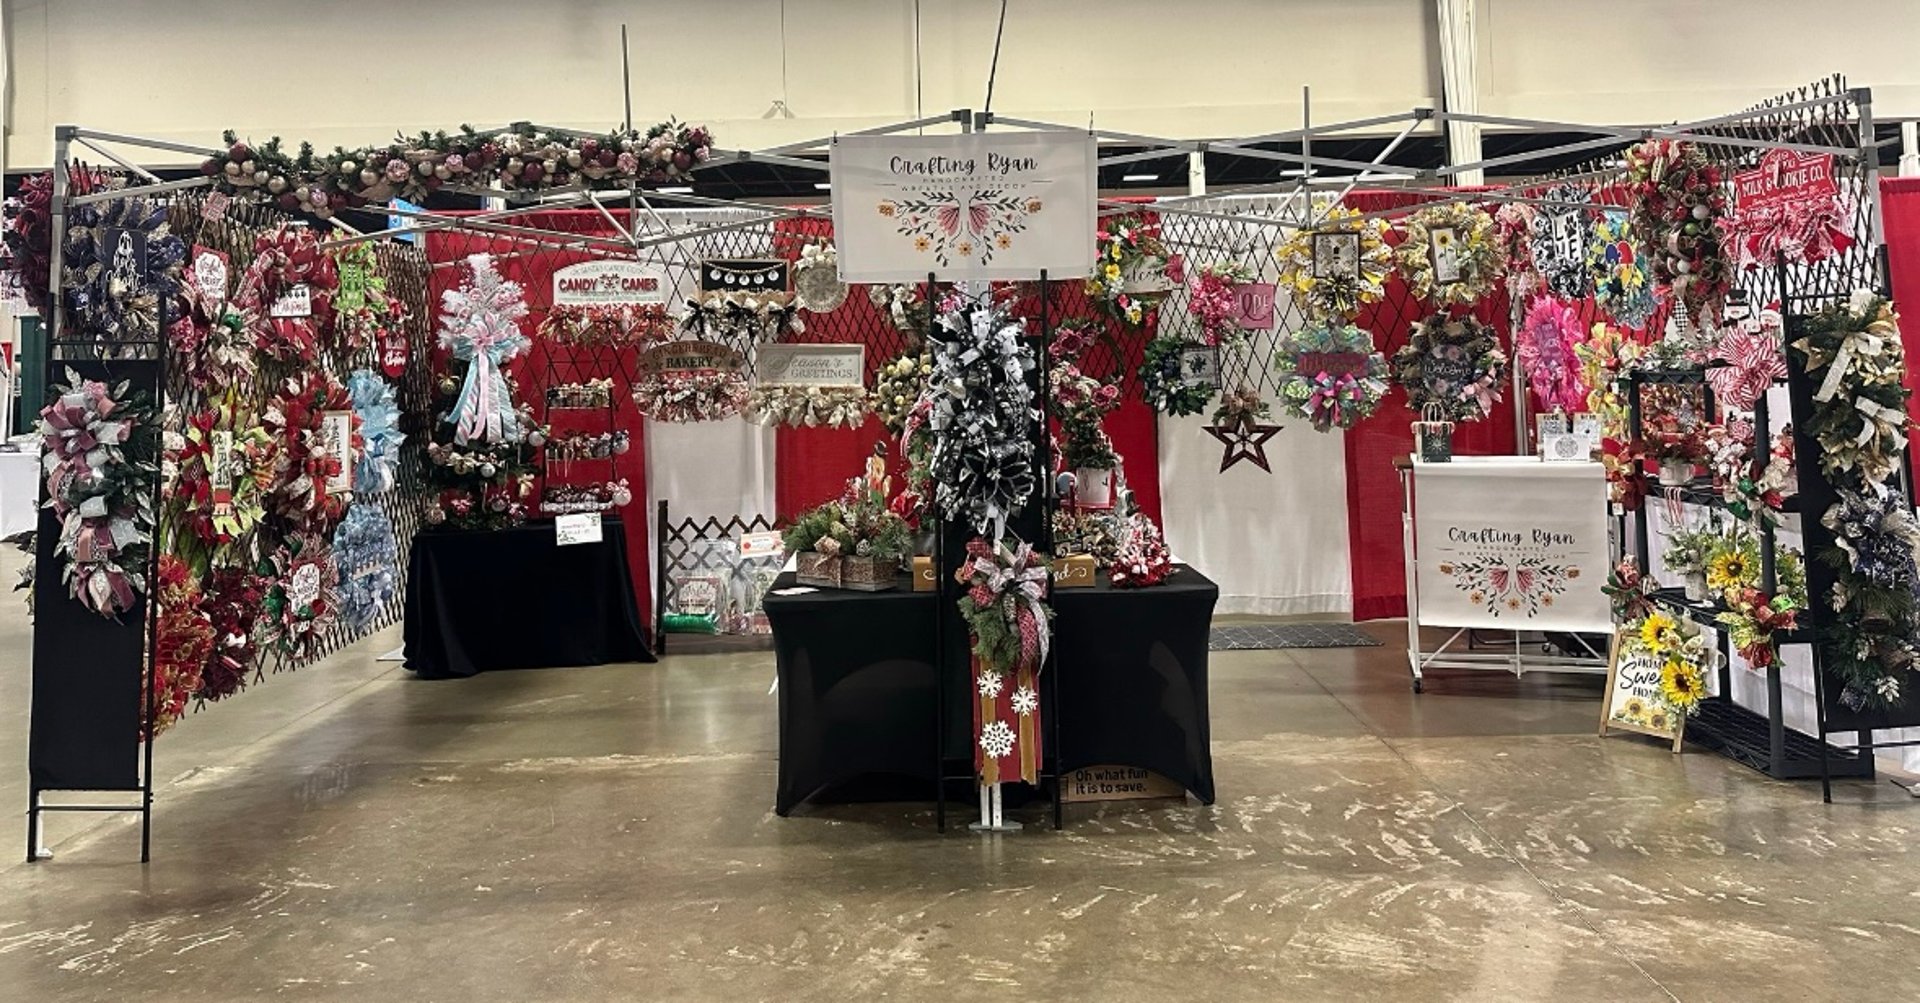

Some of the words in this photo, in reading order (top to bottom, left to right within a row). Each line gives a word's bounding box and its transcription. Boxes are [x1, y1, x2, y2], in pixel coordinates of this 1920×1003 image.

[889, 155, 977, 175] Crafting
[987, 152, 1039, 175] Ryan
[922, 175, 1005, 184] HANDCRAFTED
[1741, 179, 1766, 198] MILK
[1775, 168, 1808, 190] OOKIE
[901, 184, 954, 192] WREATHS
[960, 183, 982, 191] AND
[989, 182, 1028, 190] DECOR
[558, 278, 598, 291] CANDY
[621, 278, 659, 291] CANES
[666, 356, 714, 369] BAKERY
[1448, 527, 1523, 546] Crafting
[1532, 528, 1575, 547] Ryan
[1075, 770, 1092, 782] Oh
[1094, 769, 1125, 781] what
[1128, 767, 1148, 780] fun
[1075, 782, 1087, 795] it
[1087, 782, 1098, 794] is
[1101, 783, 1113, 794] to
[1115, 783, 1147, 793] save.
